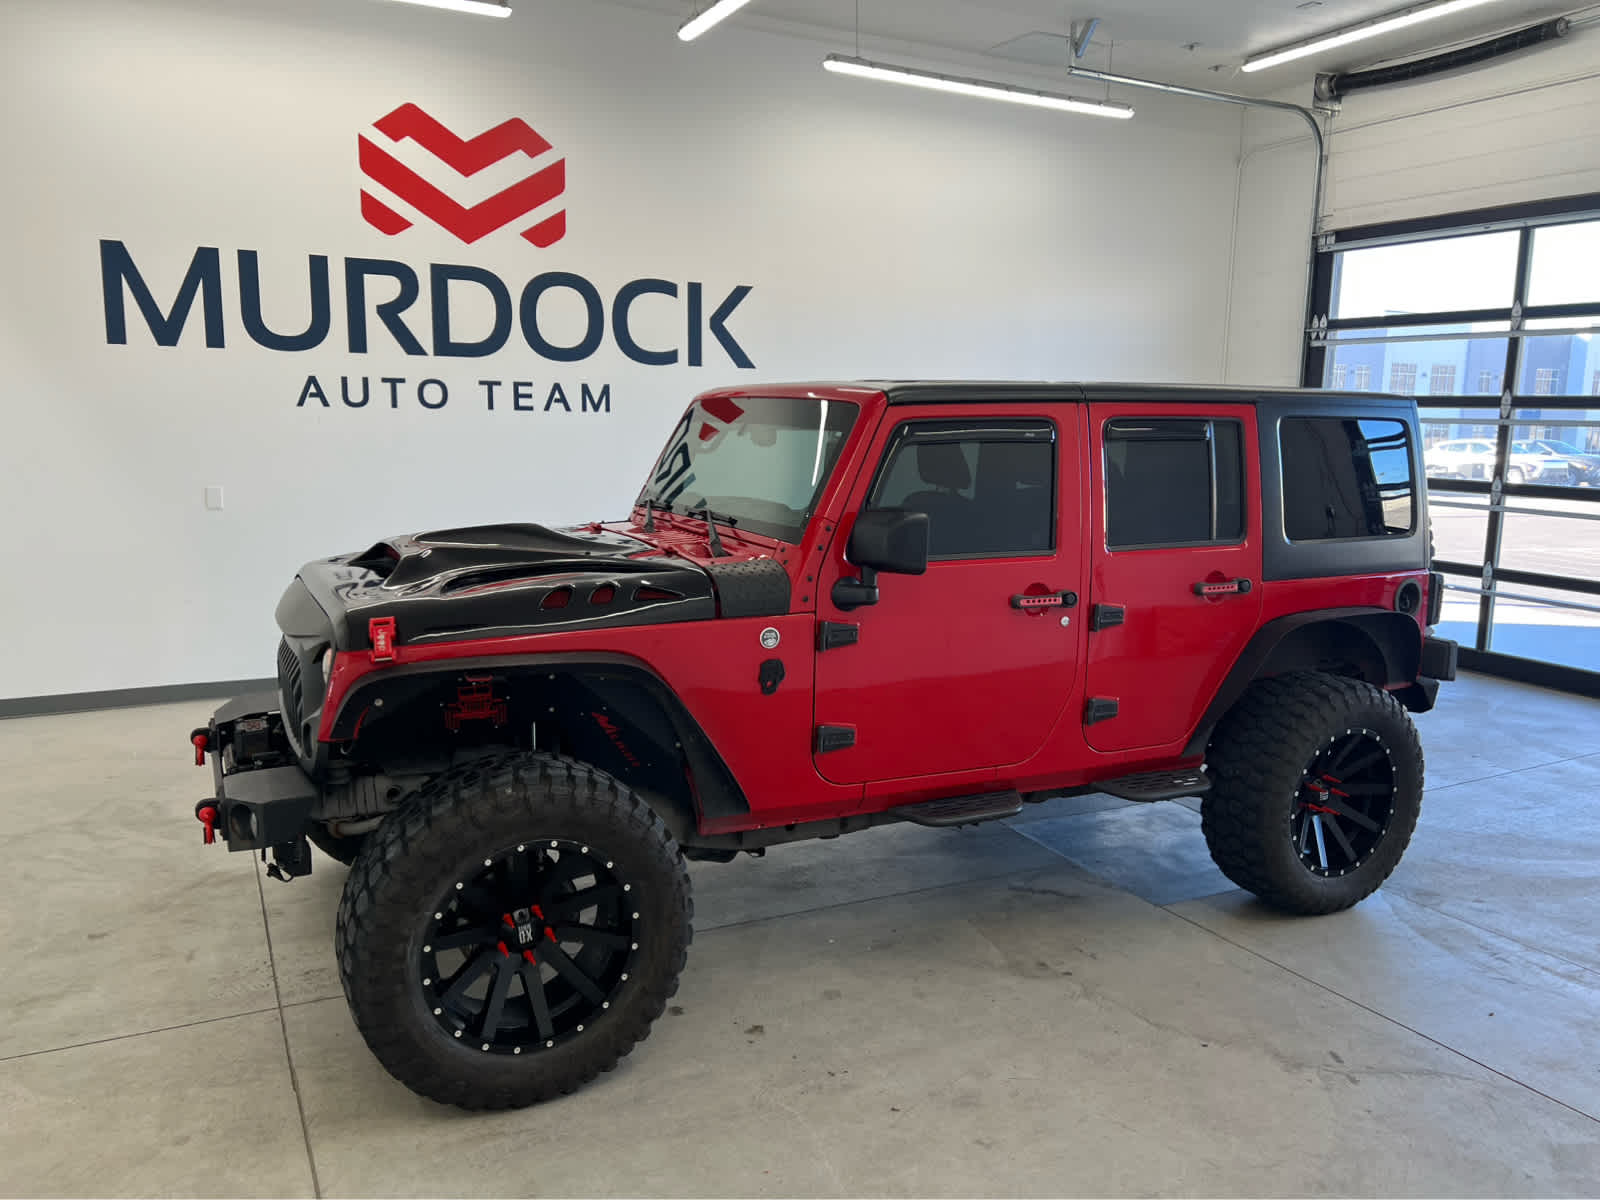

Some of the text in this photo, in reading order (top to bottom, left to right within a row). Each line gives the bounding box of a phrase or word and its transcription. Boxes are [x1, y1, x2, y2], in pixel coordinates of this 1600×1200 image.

[100, 240, 756, 369] MURDOCK
[297, 375, 611, 413] AUTO TEAM
